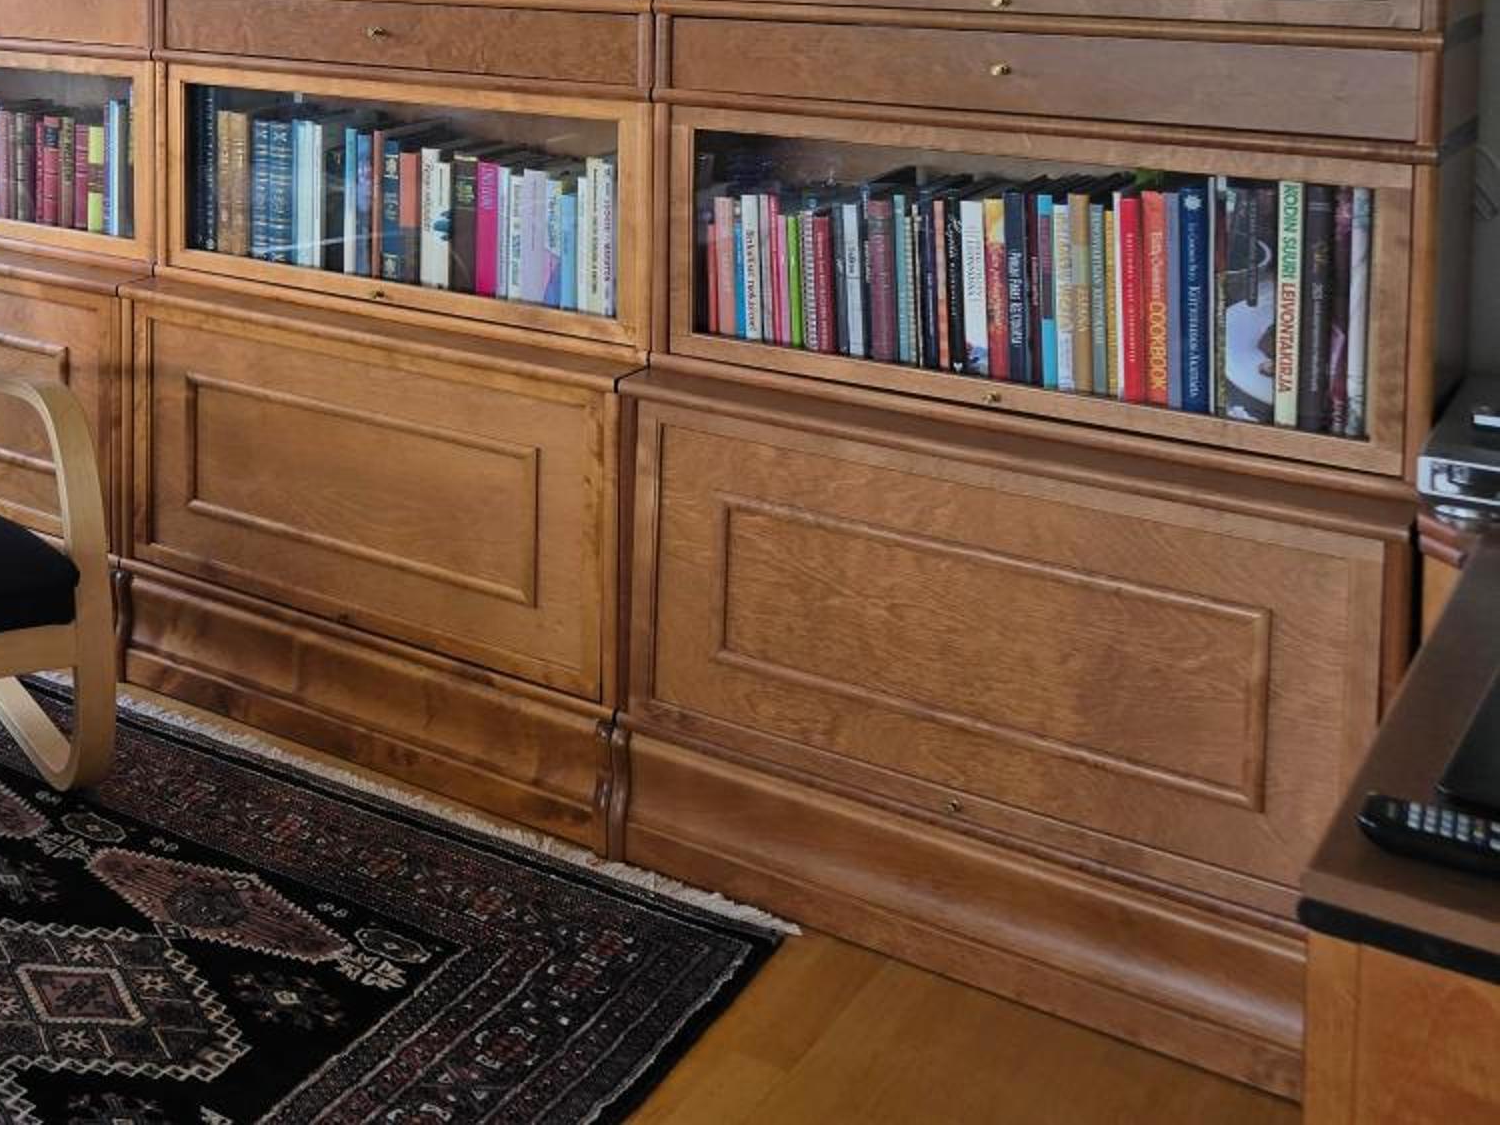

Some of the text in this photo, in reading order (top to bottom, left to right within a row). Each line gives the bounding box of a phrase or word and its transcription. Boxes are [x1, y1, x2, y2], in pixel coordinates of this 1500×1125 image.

[1148, 301, 1168, 392] COOKBOOK
[1277, 183, 1301, 396] KODIN SUURI LEIVONTAKIRJA
